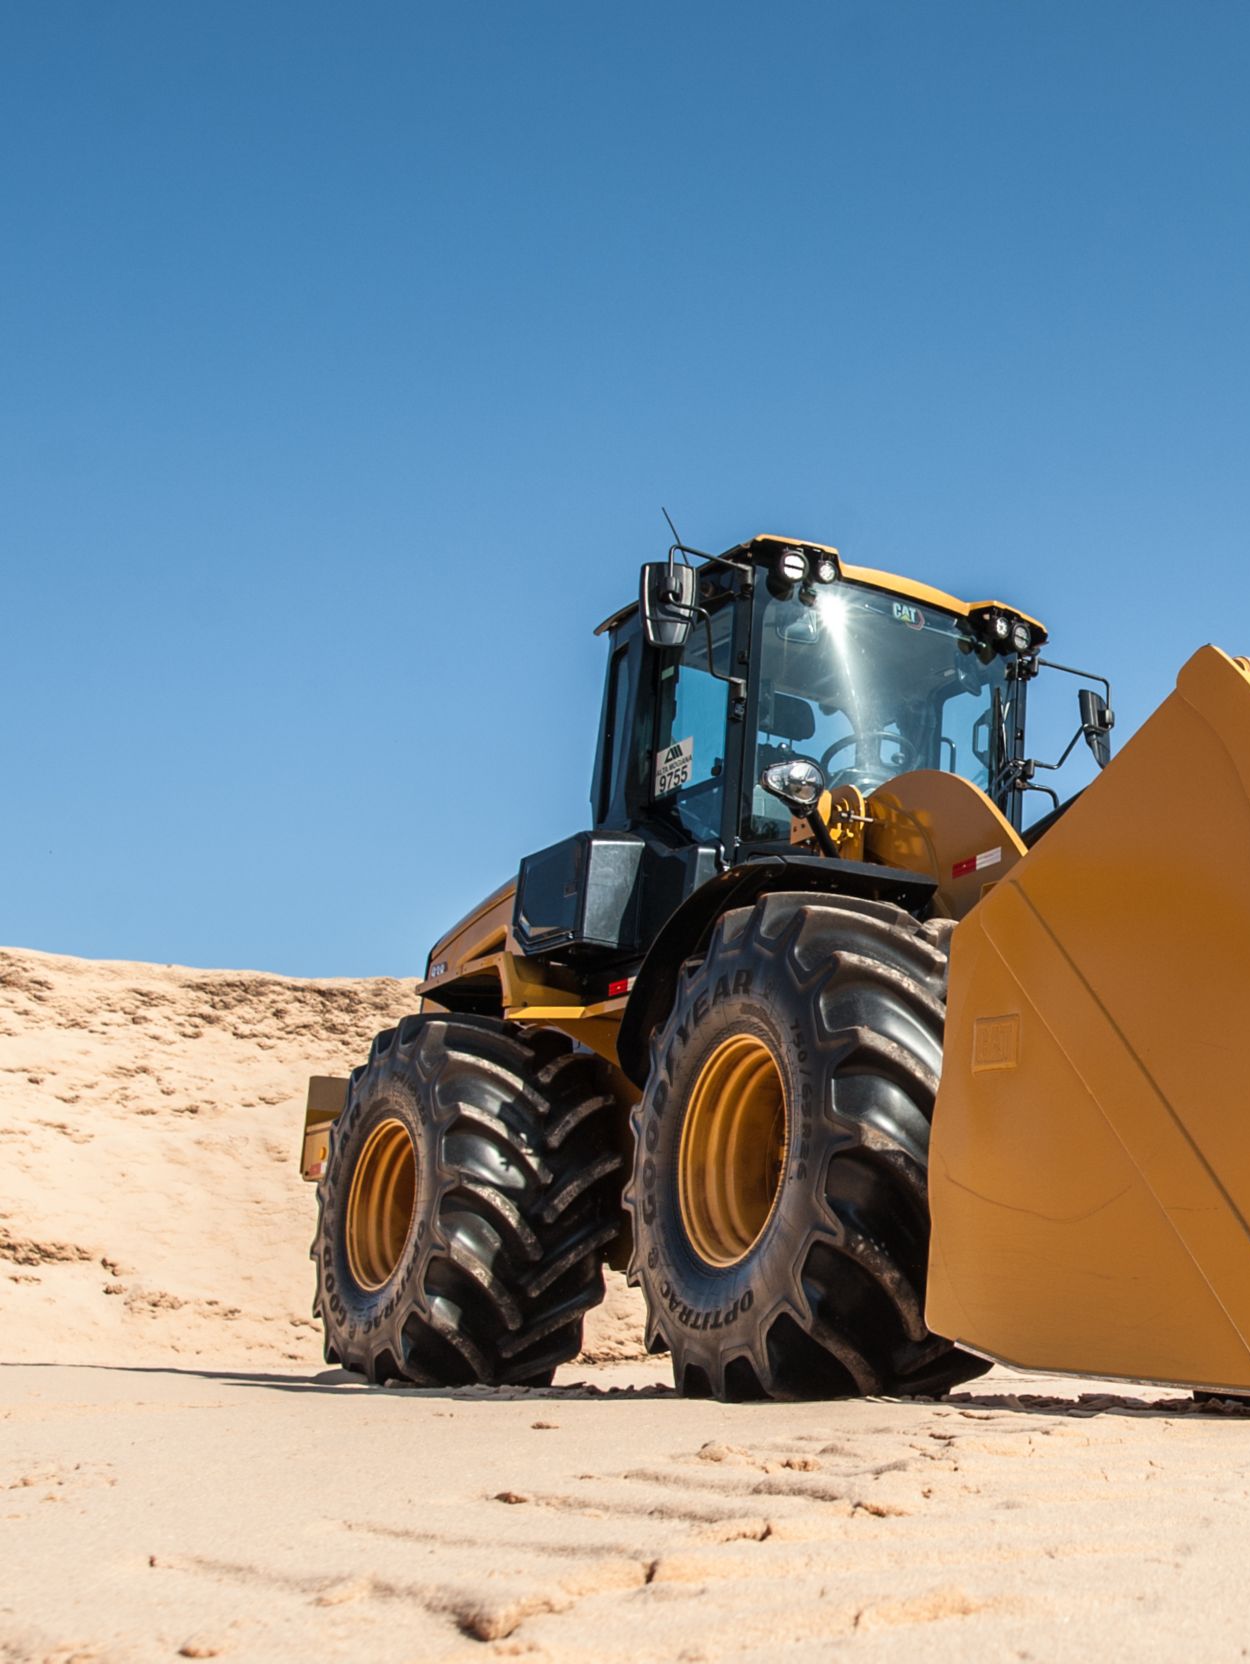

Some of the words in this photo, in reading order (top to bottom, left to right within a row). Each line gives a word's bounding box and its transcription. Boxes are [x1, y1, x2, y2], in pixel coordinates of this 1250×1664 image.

[893, 602, 916, 623] CAT
[660, 765, 688, 792] 9755
[660, 1280, 754, 1331] OPTITRAC
